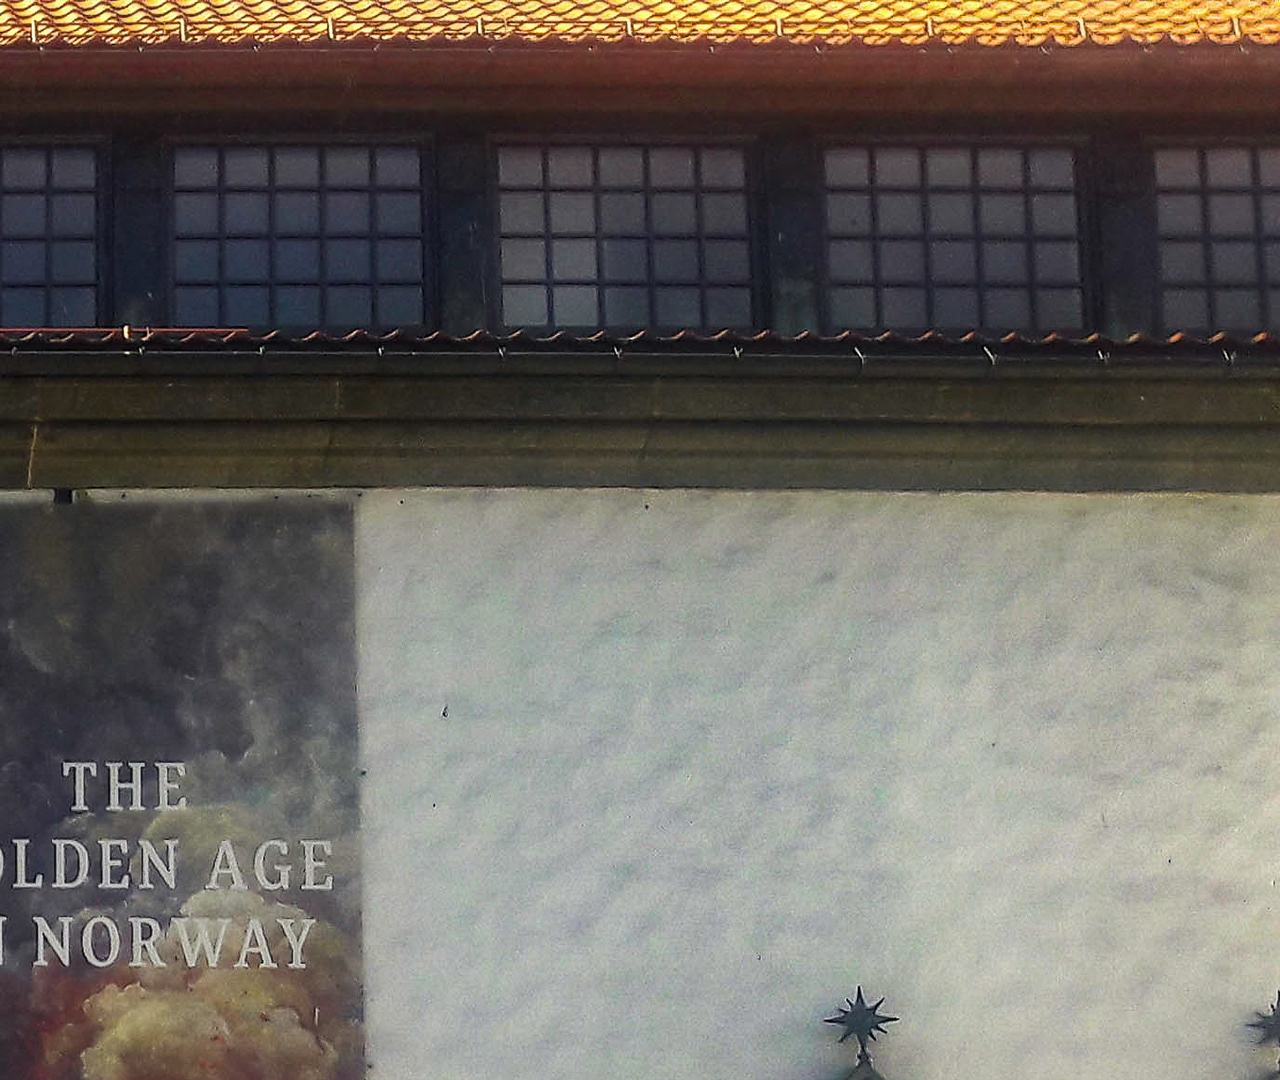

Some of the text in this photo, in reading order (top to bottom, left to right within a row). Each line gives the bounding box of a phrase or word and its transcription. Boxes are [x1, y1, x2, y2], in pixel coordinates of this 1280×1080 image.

[62, 761, 188, 812] THE
[204, 839, 335, 891] AGE
[33, 915, 317, 969] NORWAY
